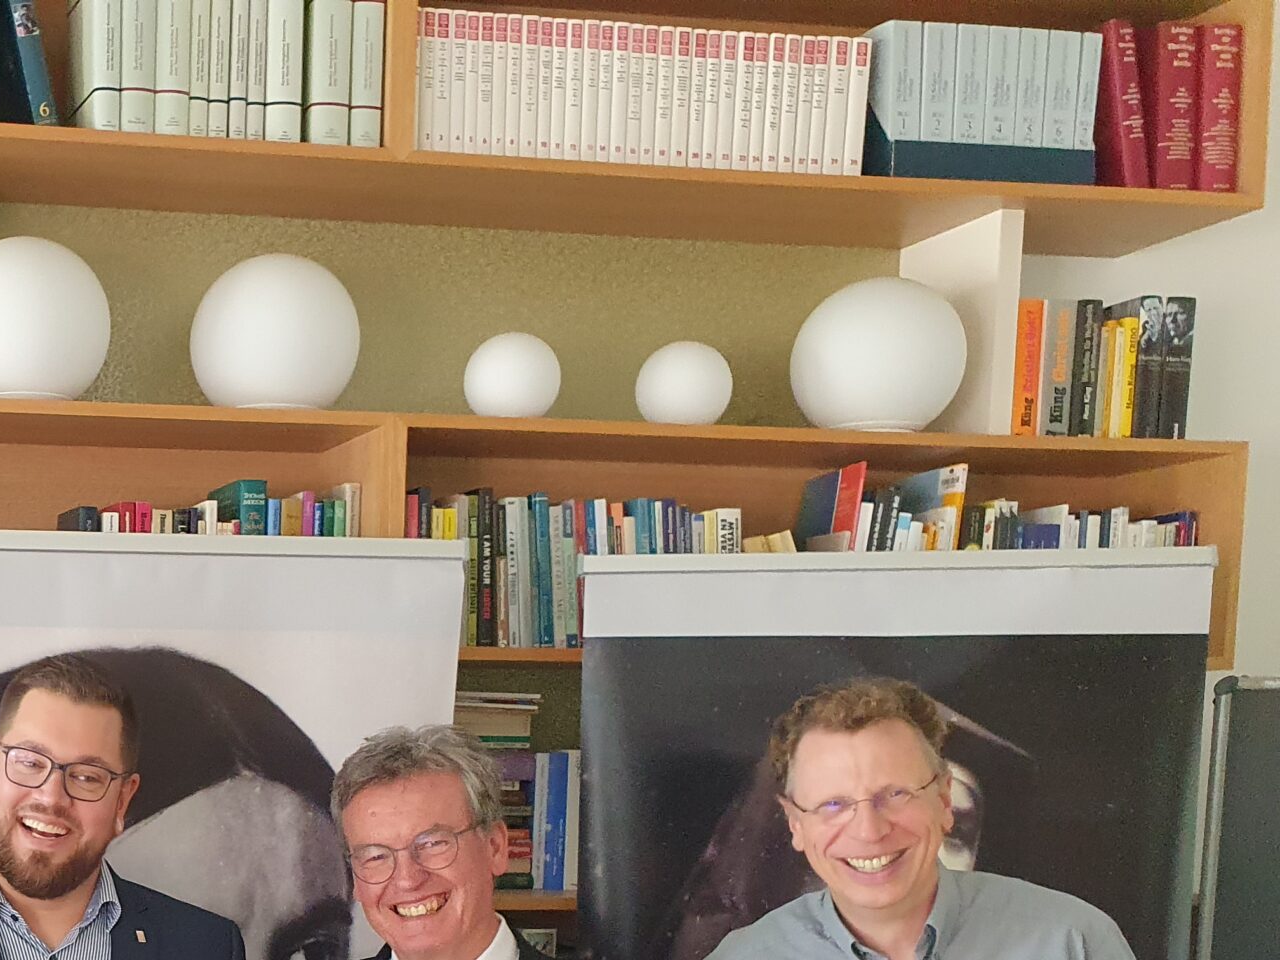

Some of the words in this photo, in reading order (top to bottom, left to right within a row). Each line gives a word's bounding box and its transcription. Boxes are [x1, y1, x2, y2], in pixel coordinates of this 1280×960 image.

[39, 102, 50, 117] 6
[482, 541, 489, 556] AM
[482, 559, 490, 584] YOUR
